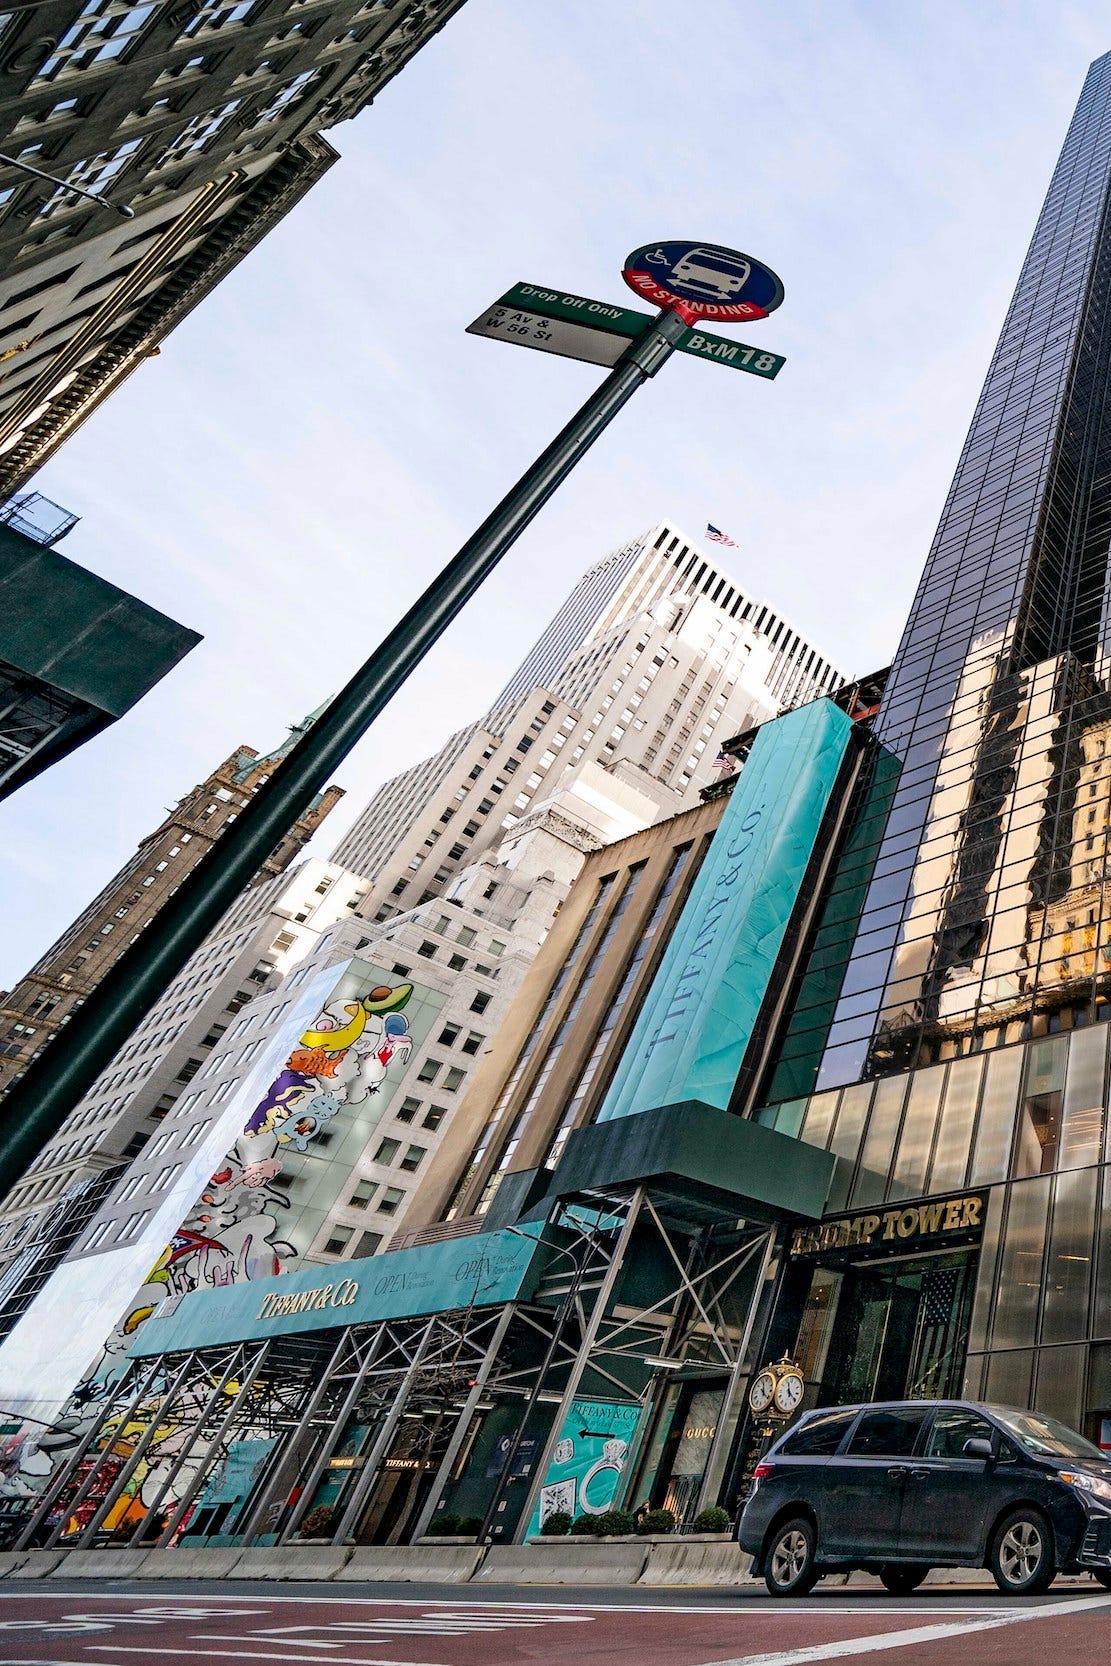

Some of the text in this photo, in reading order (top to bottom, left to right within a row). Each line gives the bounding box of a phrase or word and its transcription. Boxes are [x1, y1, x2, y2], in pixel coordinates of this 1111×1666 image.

[520, 286, 623, 319] Drop Off Only
[631, 274, 654, 290] NO
[653, 290, 753, 315] STANDING
[486, 317, 553, 341] W 56 St
[494, 309, 550, 329] 5 Av &
[686, 334, 777, 372] BxM18
[644, 896, 730, 1060] TIFFANY
[789, 1196, 984, 1255] TRUMP TOWER
[571, 1402, 612, 1418] TIFFANY
[686, 1426, 716, 1439] GUCC
[385, 1459, 414, 1468] TIFFANY
